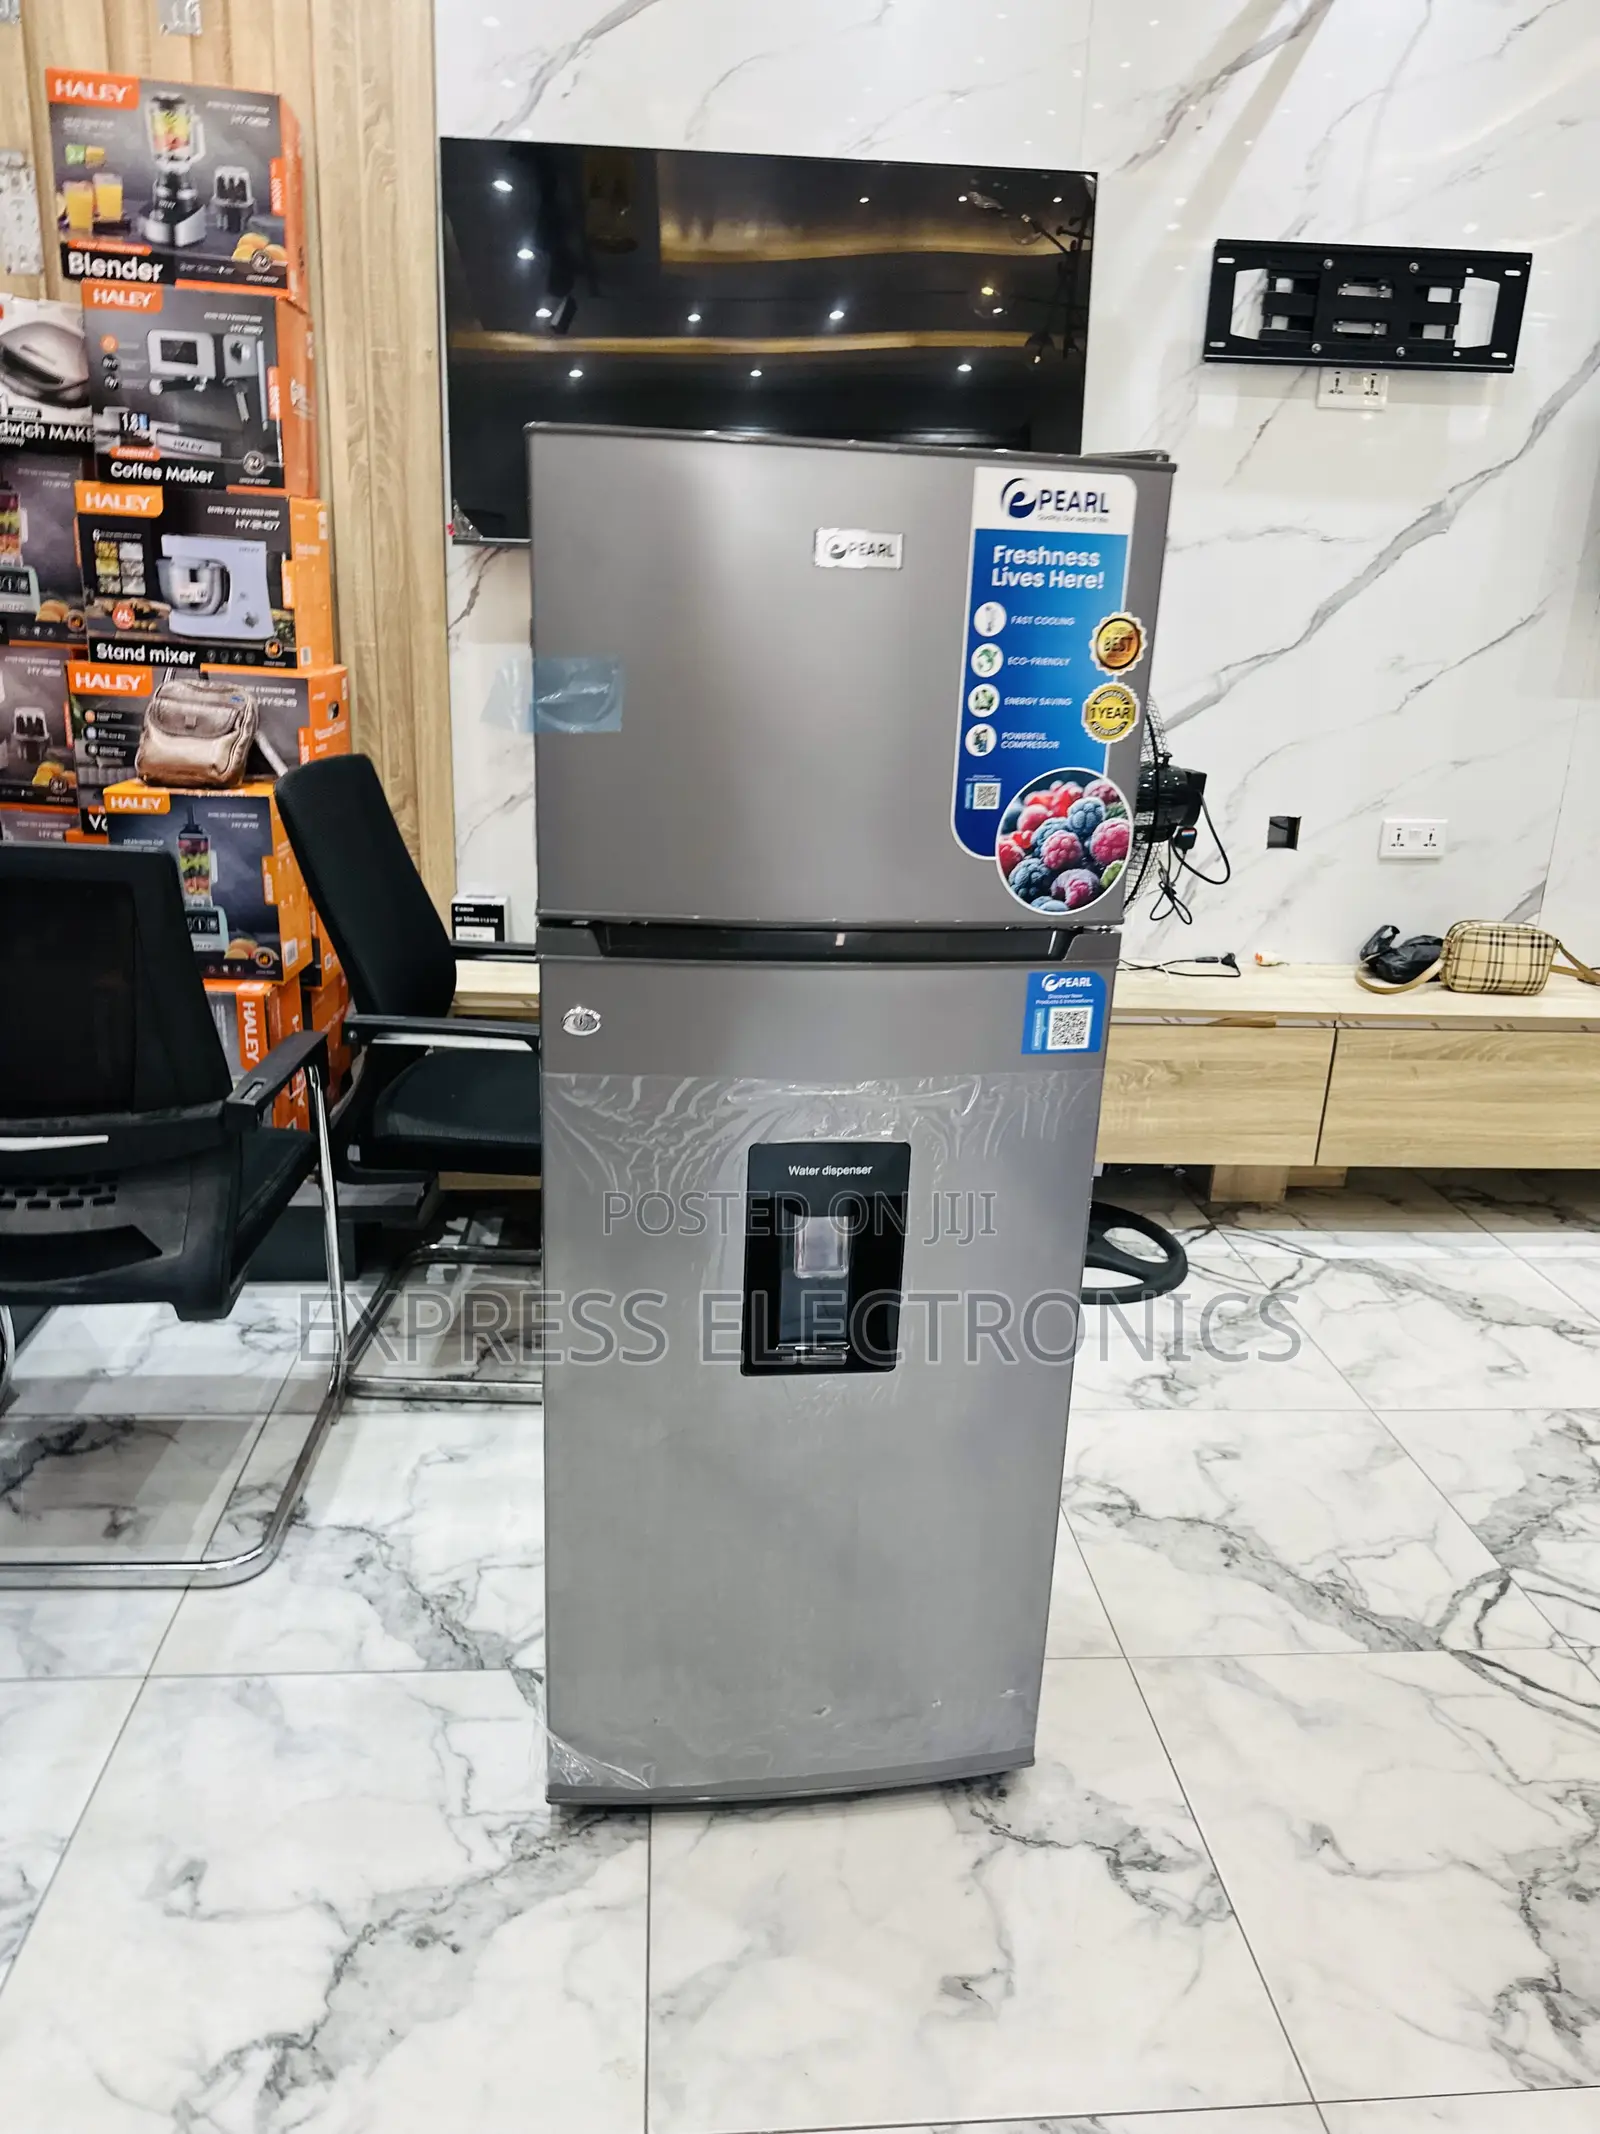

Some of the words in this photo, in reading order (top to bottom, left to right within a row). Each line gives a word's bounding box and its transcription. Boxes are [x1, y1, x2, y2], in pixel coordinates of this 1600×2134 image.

[55, 78, 127, 103] HALEY
[67, 251, 164, 282] Blender
[92, 288, 155, 308] HALEY
[110, 461, 162, 481] Coffee
[165, 465, 215, 484] Maker
[85, 491, 151, 512] HALEY
[1039, 489, 1110, 513] PEARL
[847, 542, 895, 558] PEARL
[993, 545, 1101, 567] Freshness
[991, 566, 1045, 588] Lives
[1048, 569, 1105, 590] Here!
[1010, 615, 1034, 626] FAST
[1034, 616, 1076, 627] COOLING
[1103, 637, 1134, 652] BEST
[96, 643, 146, 663] Stand
[150, 645, 196, 665] mixer
[1007, 656, 1071, 667] ECO-FRIENDLY
[76, 671, 141, 692] HALEY
[1004, 696, 1038, 706] ENERGY
[1039, 697, 1073, 707] SAVING
[1089, 708, 1098, 719] 1
[1099, 708, 1131, 720] YEAR
[1000, 741, 1060, 750] COMPRESSOR
[1001, 732, 1048, 741] POWERFUL
[110, 795, 161, 810] HALEY
[1058, 977, 1092, 988] PEARL
[242, 1001, 260, 1063] HALEY
[788, 1165, 820, 1176] Water
[821, 1165, 873, 1178] dispenser
